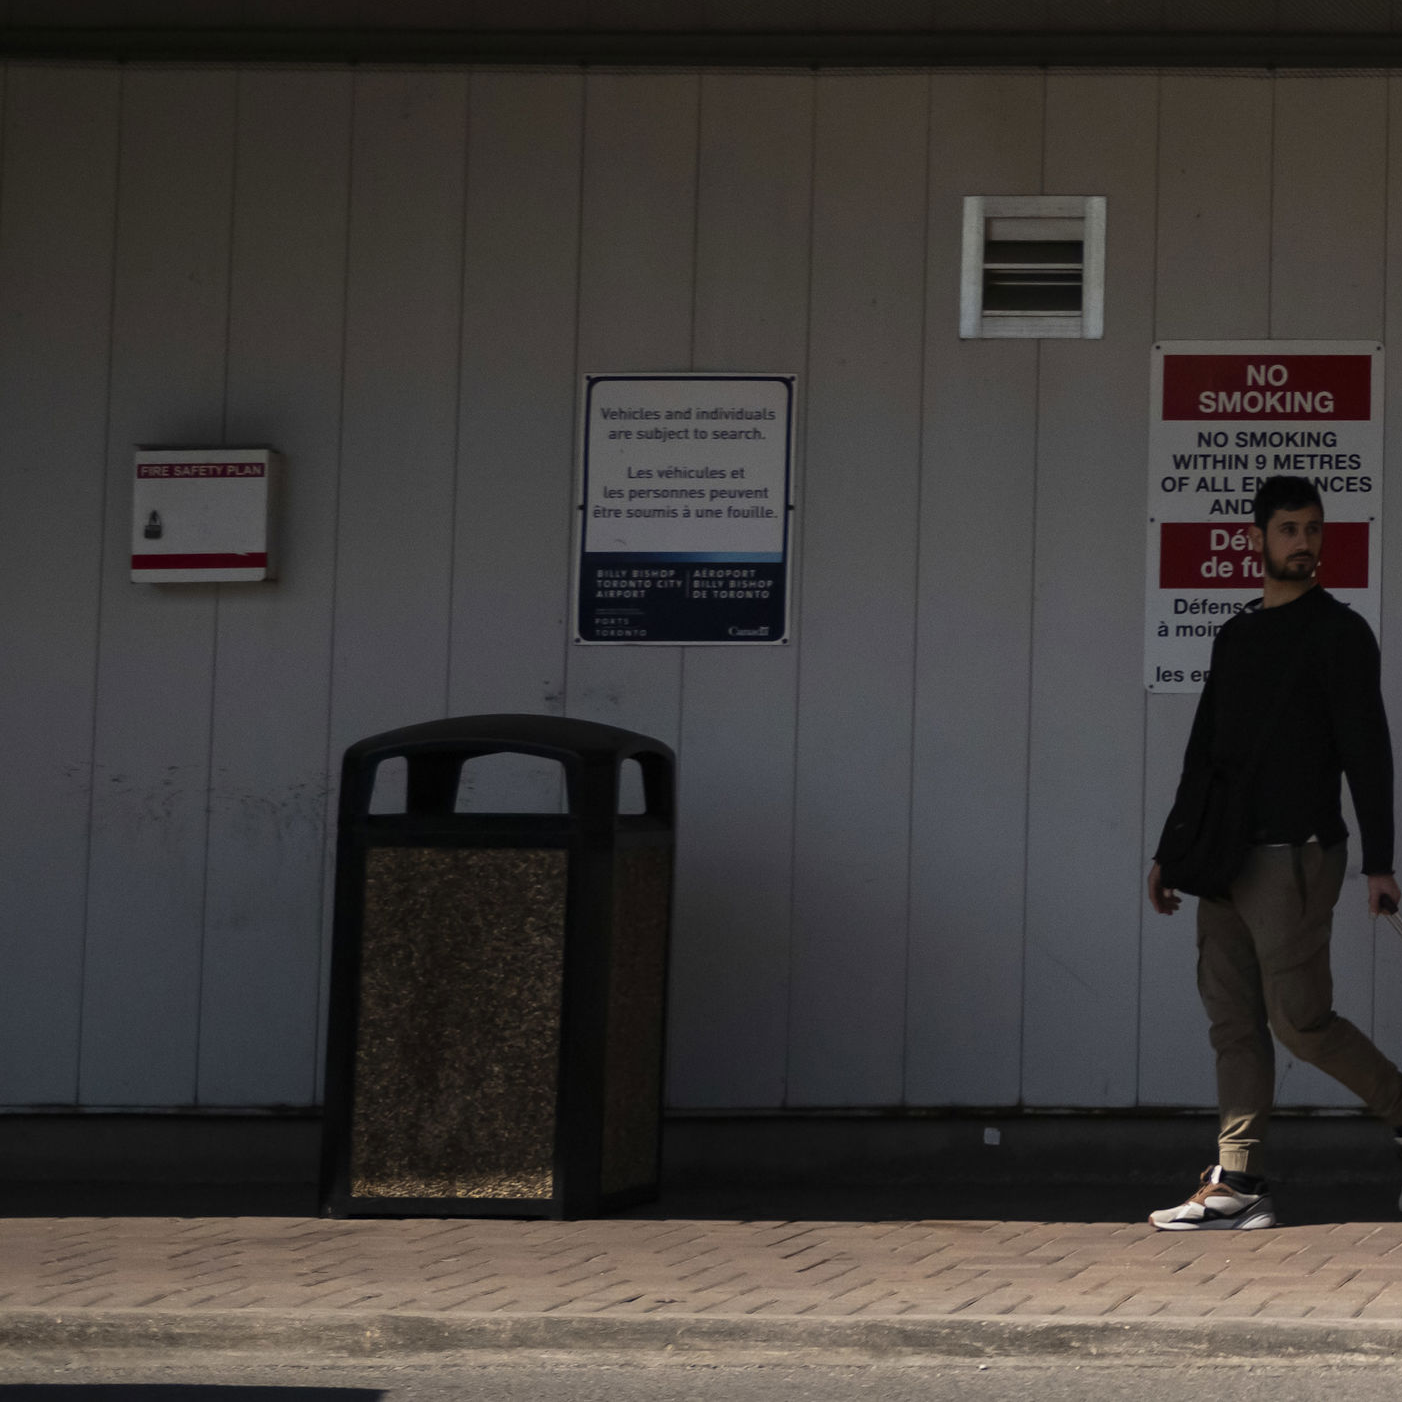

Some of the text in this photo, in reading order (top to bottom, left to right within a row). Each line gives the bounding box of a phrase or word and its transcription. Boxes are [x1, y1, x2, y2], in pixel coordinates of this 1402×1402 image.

[1248, 365, 1287, 386] NO
[1199, 391, 1333, 413] SMOKING
[601, 408, 776, 421] Vehicles and individuals
[609, 428, 765, 442] are subject to search.
[1198, 432, 1336, 449] NO SMOKING
[1173, 453, 1360, 471] WITHIN 9 METRES
[141, 465, 261, 476] FIRE SAFETY PLAN
[628, 467, 745, 478] Les véhicules et
[1162, 476, 1191, 492] OF
[1196, 476, 1235, 492] ALL
[604, 486, 768, 501] les personnes peuvent
[593, 505, 777, 519] être soumis à une fouille.
[1210, 499, 1255, 515] AND
[597, 570, 676, 578] BILLY BISHOP
[1201, 555, 1234, 578] de
[597, 580, 683, 588] TORONTO CITY
[693, 580, 773, 588] BILLY BISHOP
[596, 590, 646, 598] AIRPORT
[693, 590, 769, 599] DE TORONTO
[1174, 597, 1248, 615] Défens
[1157, 620, 1169, 637] à
[1156, 666, 1185, 683] les
